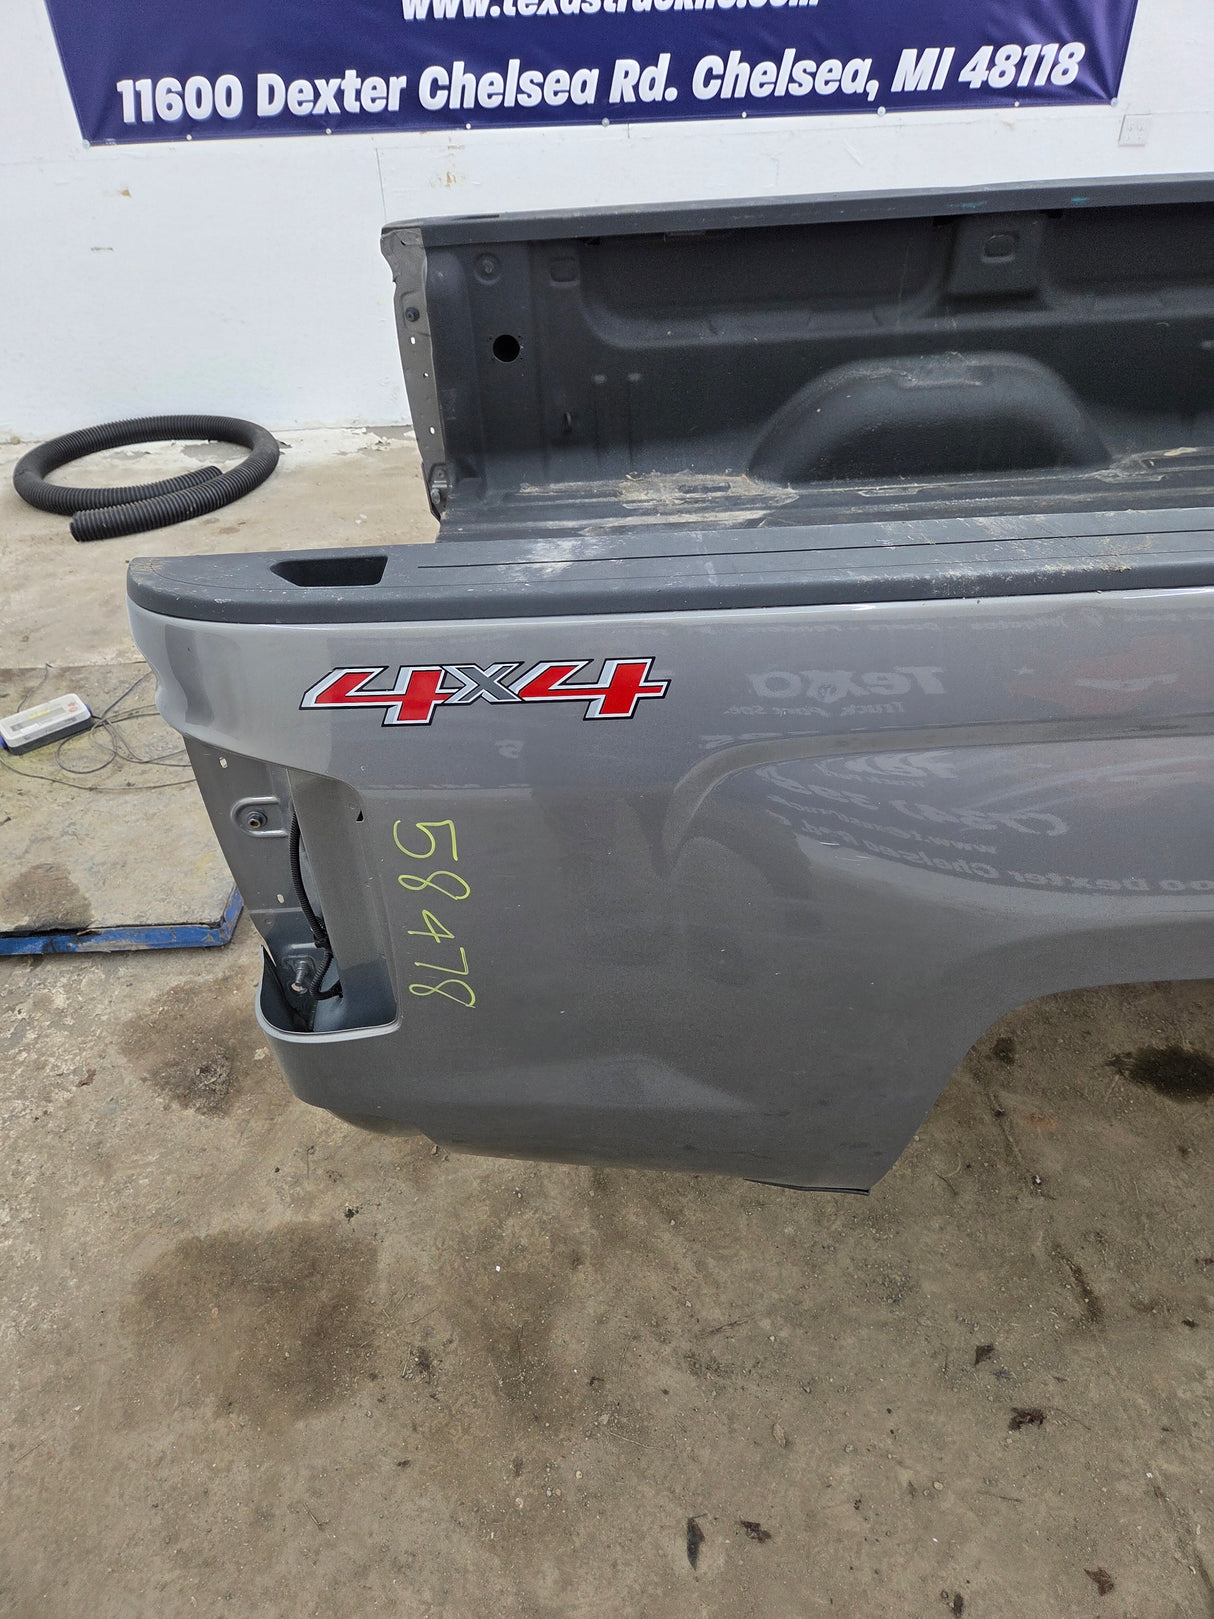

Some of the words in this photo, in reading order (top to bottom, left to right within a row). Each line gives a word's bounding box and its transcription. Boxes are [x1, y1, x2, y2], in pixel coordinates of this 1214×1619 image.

[116, 73, 244, 124] 11600
[256, 69, 408, 117] Dexter
[418, 58, 600, 111] Chelsea
[608, 52, 678, 104] Rd.
[692, 47, 880, 102] Chelsea,
[890, 46, 956, 93] MI
[957, 41, 1086, 89] 48118
